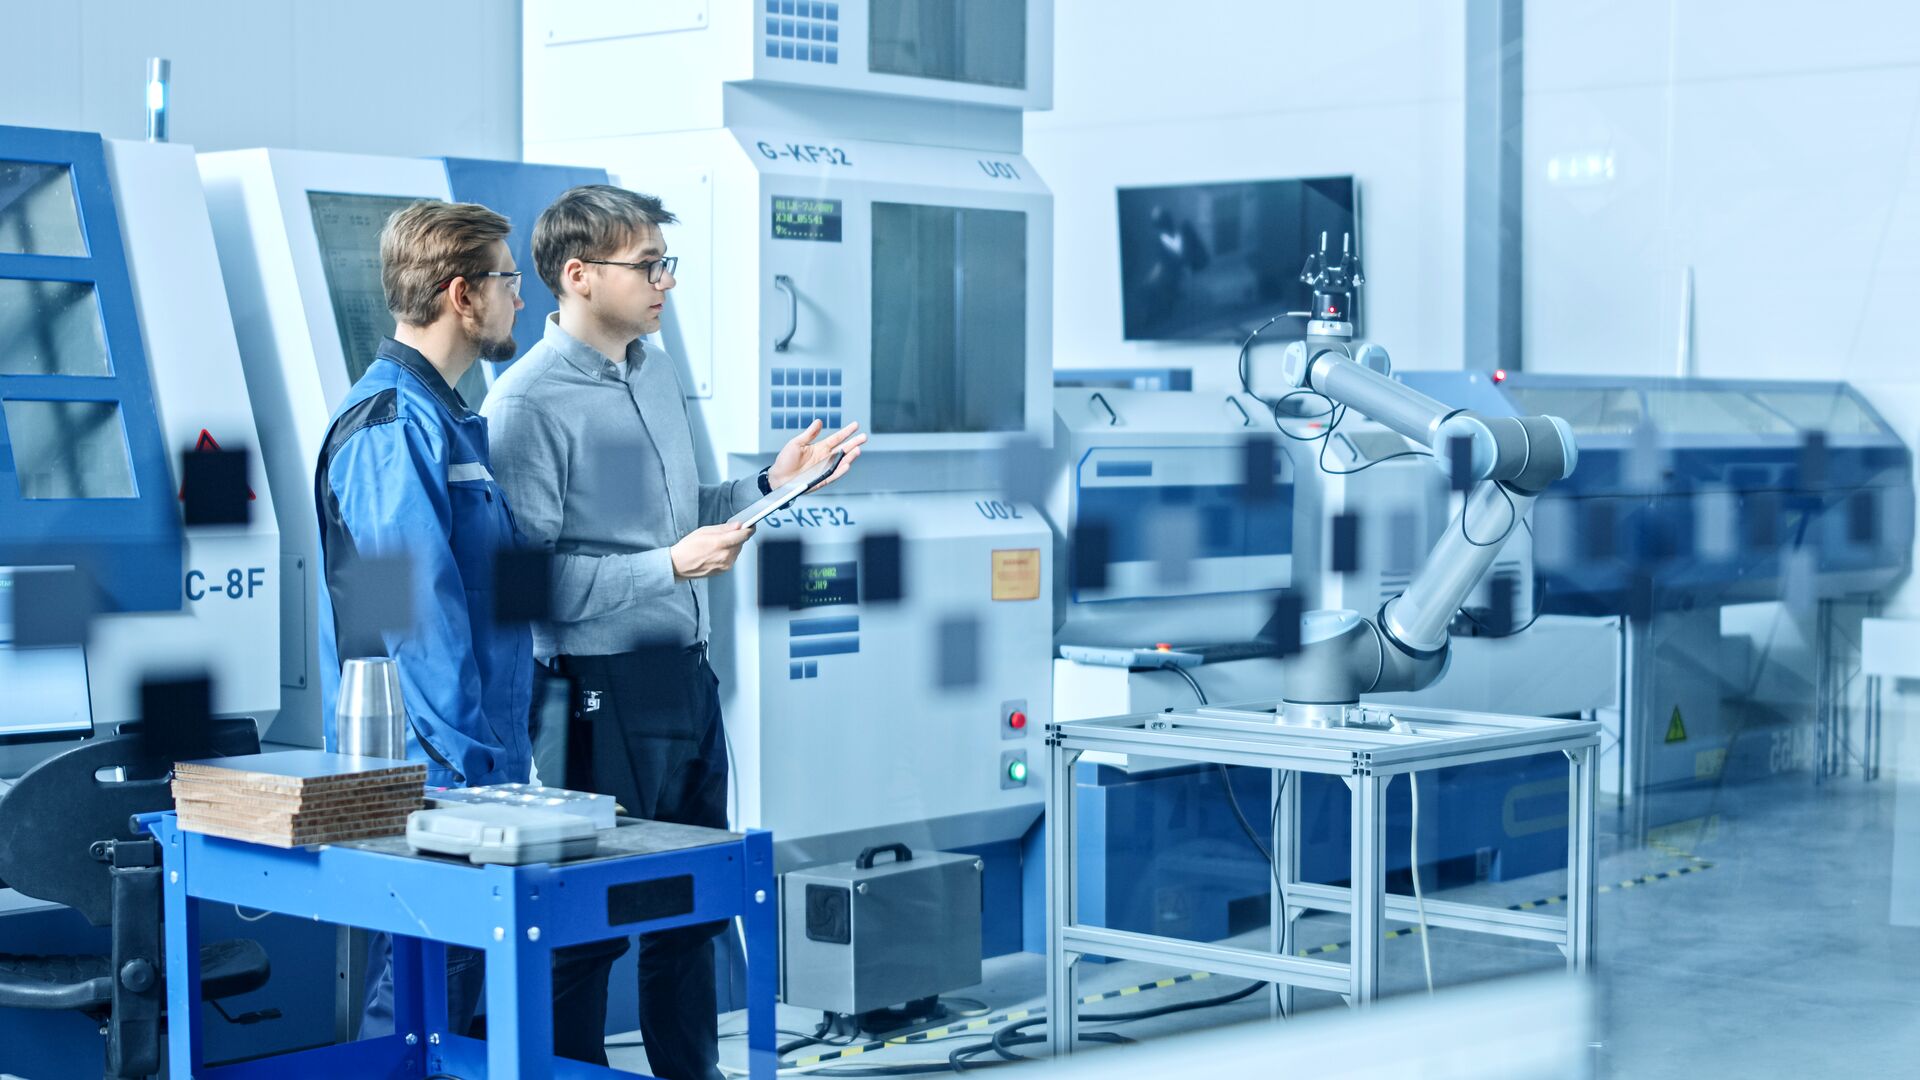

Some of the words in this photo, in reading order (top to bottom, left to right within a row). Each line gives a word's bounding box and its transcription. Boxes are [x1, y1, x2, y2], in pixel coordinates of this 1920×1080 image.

[756, 141, 853, 167] G-KF32
[977, 159, 1022, 181] U01
[975, 500, 1023, 520] U02
[185, 567, 266, 602] C-8F
